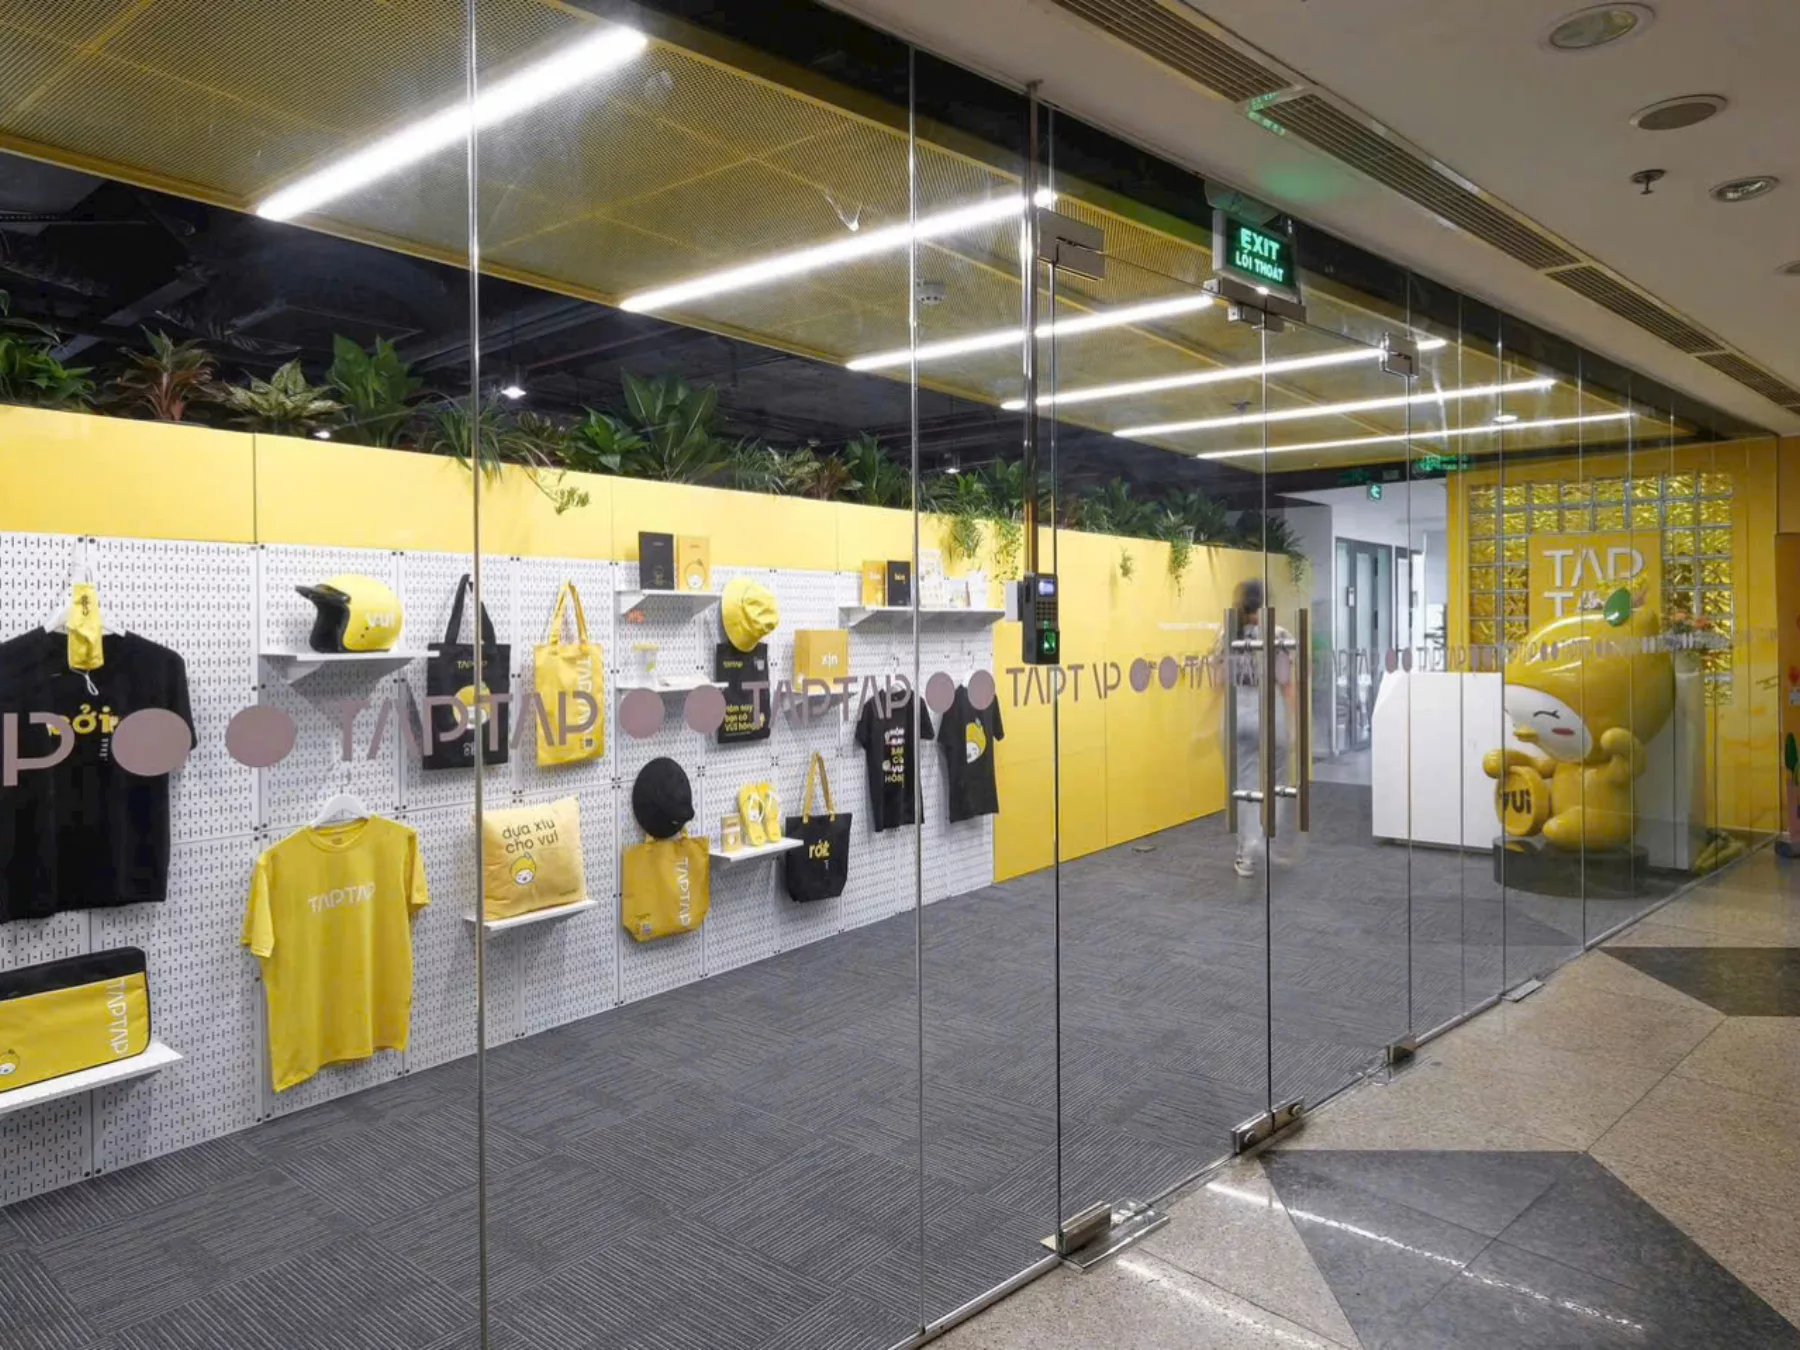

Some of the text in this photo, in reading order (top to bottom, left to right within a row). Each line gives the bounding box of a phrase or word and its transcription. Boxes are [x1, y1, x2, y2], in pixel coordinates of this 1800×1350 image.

[1240, 227, 1280, 260] EXIT
[1542, 546, 1645, 588] TAP
[741, 674, 912, 729] TAPTAP
[505, 837, 534, 854] cho
[675, 856, 692, 927] TAPTAP
[106, 977, 129, 1056] TAPTAP
